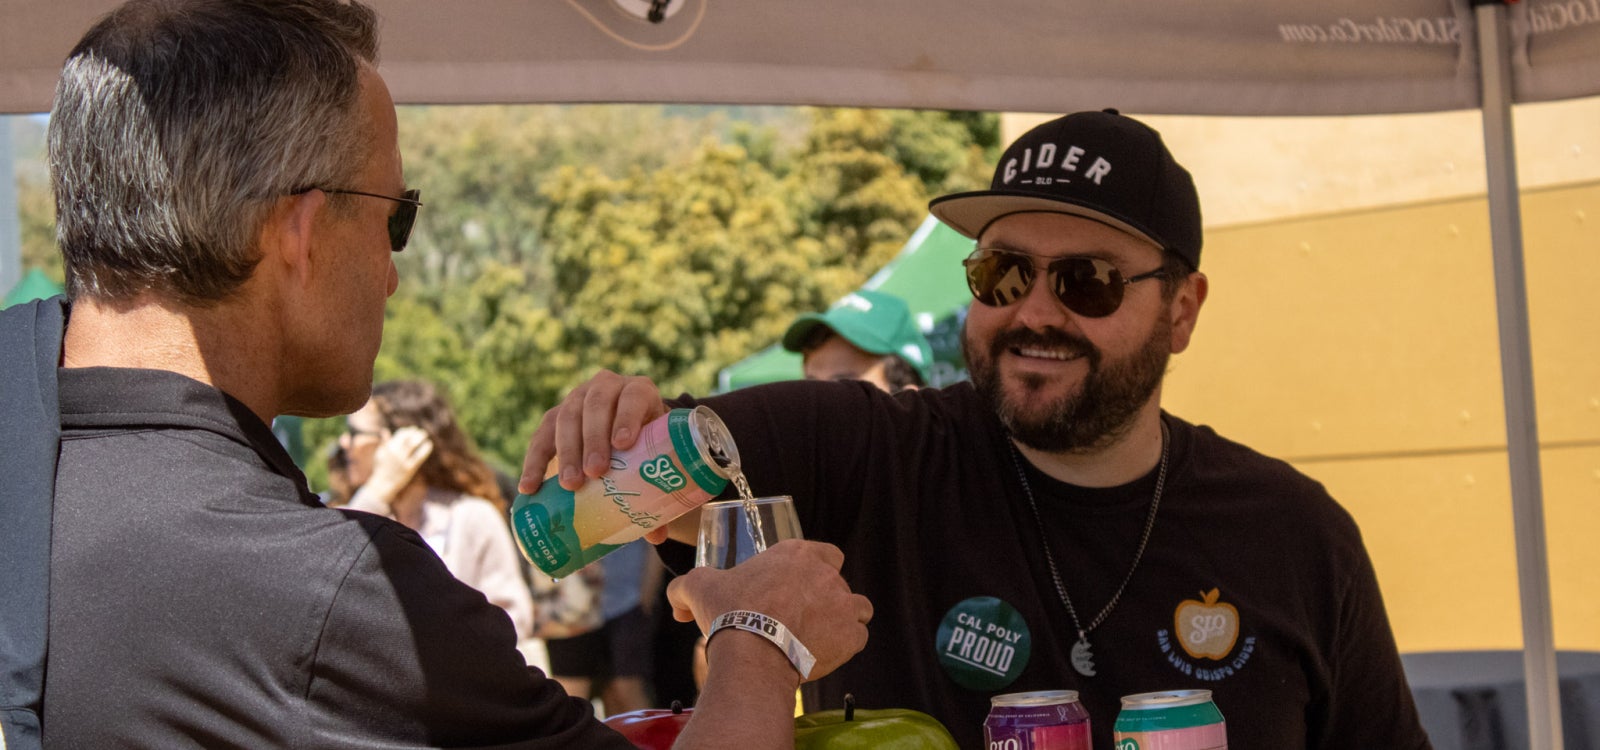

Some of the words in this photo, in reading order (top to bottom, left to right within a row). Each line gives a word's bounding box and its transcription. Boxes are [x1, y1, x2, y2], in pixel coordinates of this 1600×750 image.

[1003, 143, 1112, 185] CIDER
[642, 457, 684, 488] SLO
[524, 510, 539, 537] HARD
[537, 539, 558, 566] CIDER
[720, 615, 777, 637] OVER
[762, 616, 778, 627] AGE
[957, 612, 983, 631] CAL
[986, 622, 1022, 644] POLY
[948, 626, 1015, 673] PROUD
[1157, 629, 1171, 653] SAN
[1168, 651, 1192, 675] LUIS
